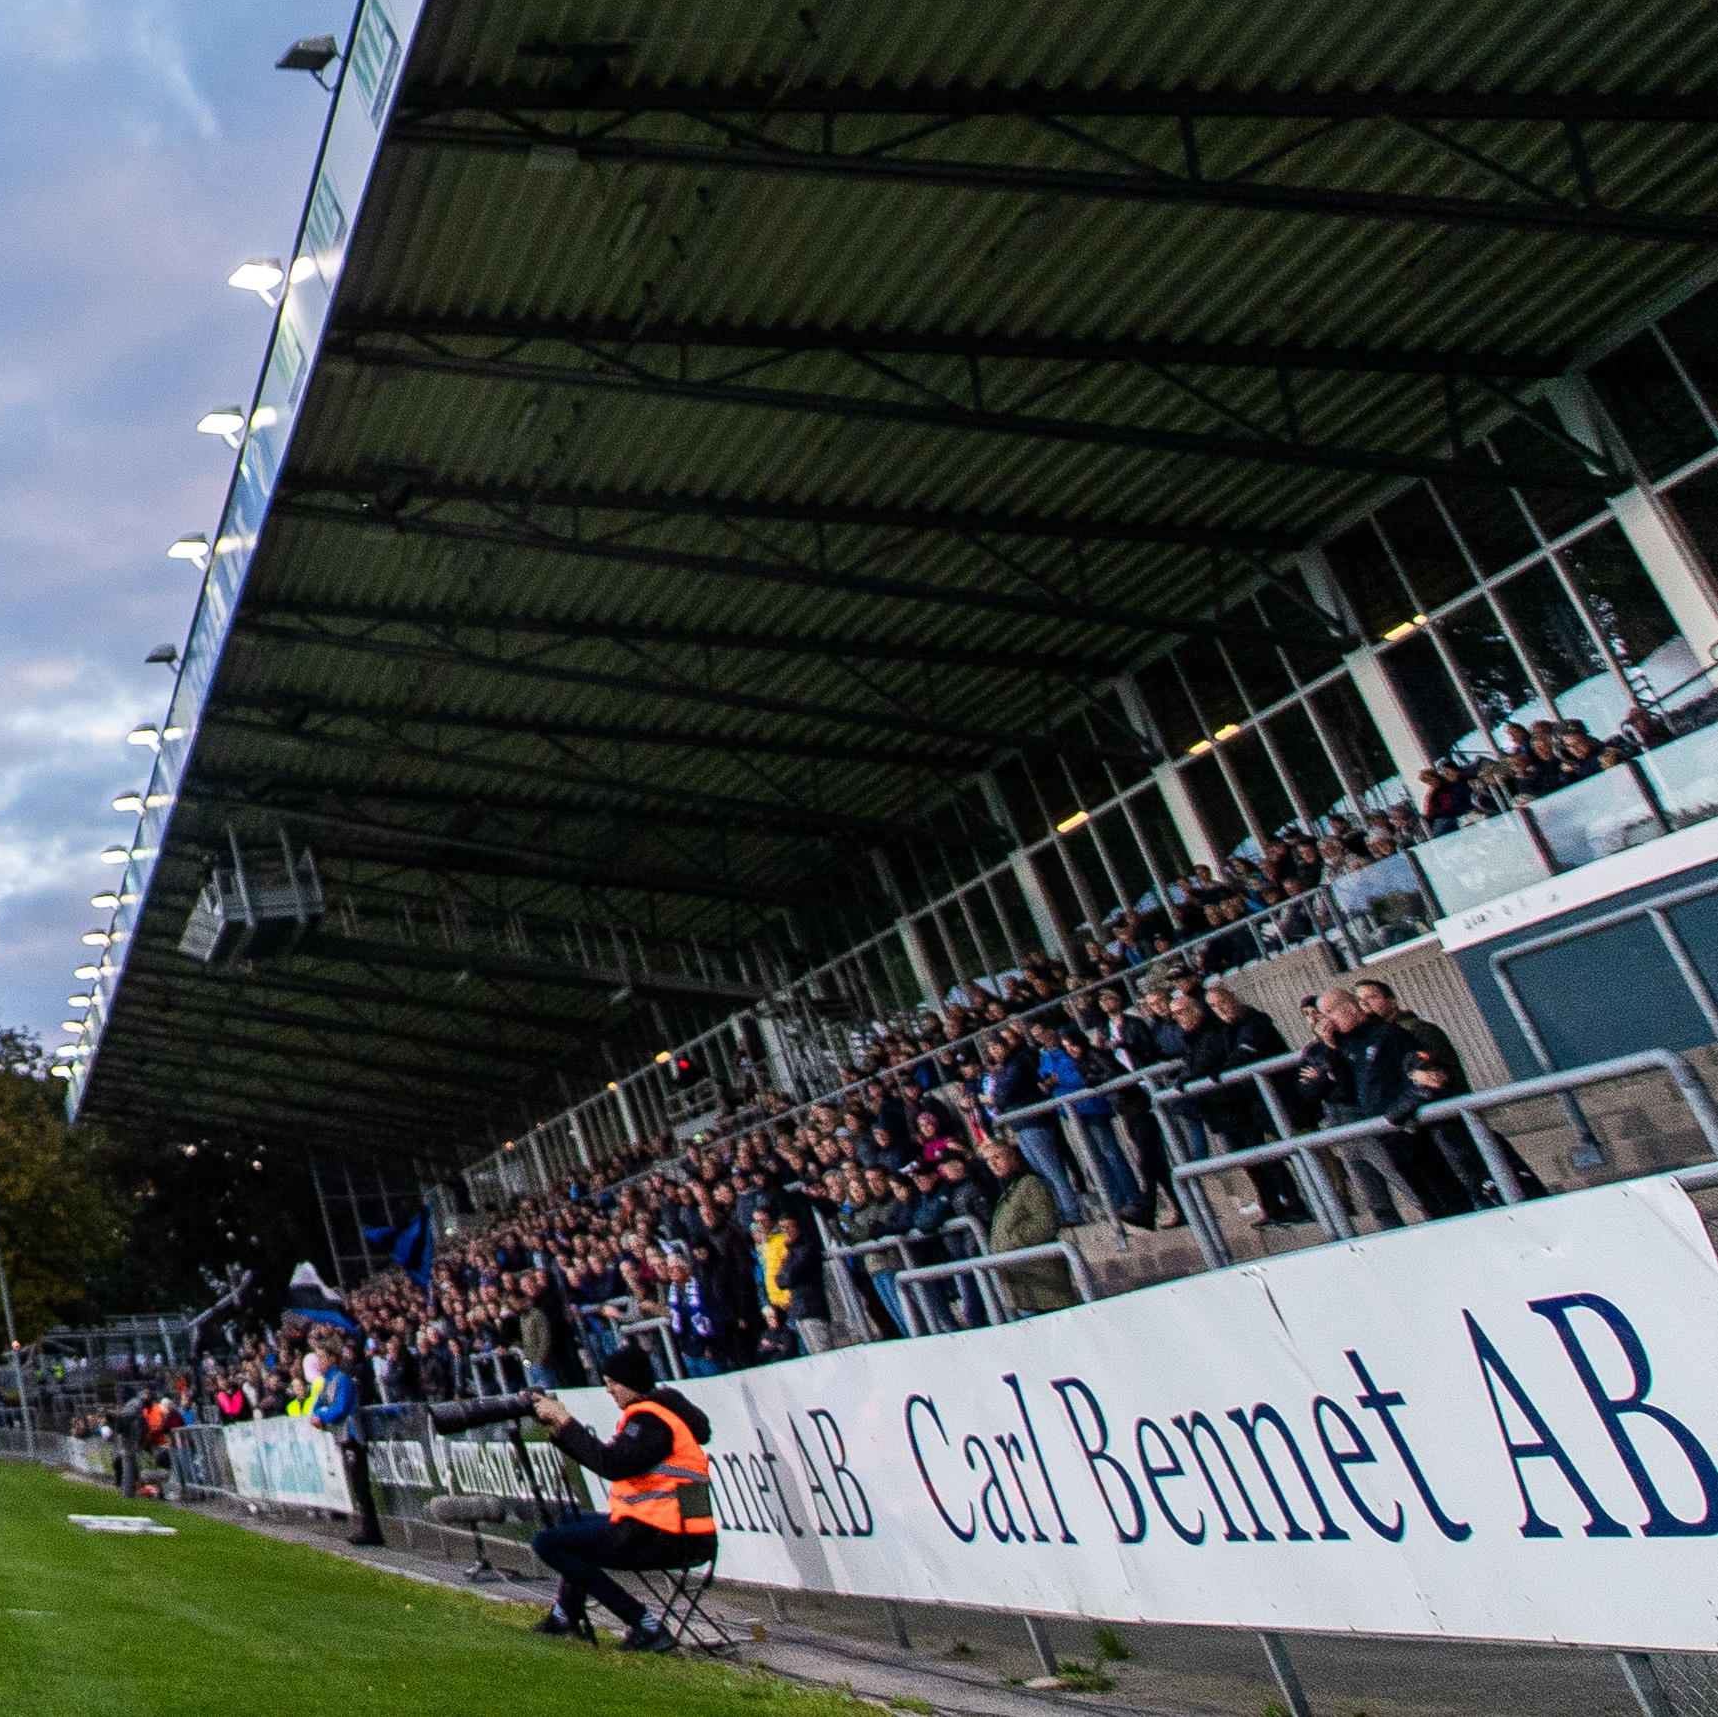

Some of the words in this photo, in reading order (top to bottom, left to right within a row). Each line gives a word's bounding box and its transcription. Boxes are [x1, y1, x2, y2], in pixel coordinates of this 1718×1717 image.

[707, 1428, 804, 1538] nnet
[787, 1408, 874, 1538] AB
[905, 1372, 1078, 1546] Carl
[1051, 1348, 1471, 1548] Bennet
[1461, 1291, 1718, 1539] AB
